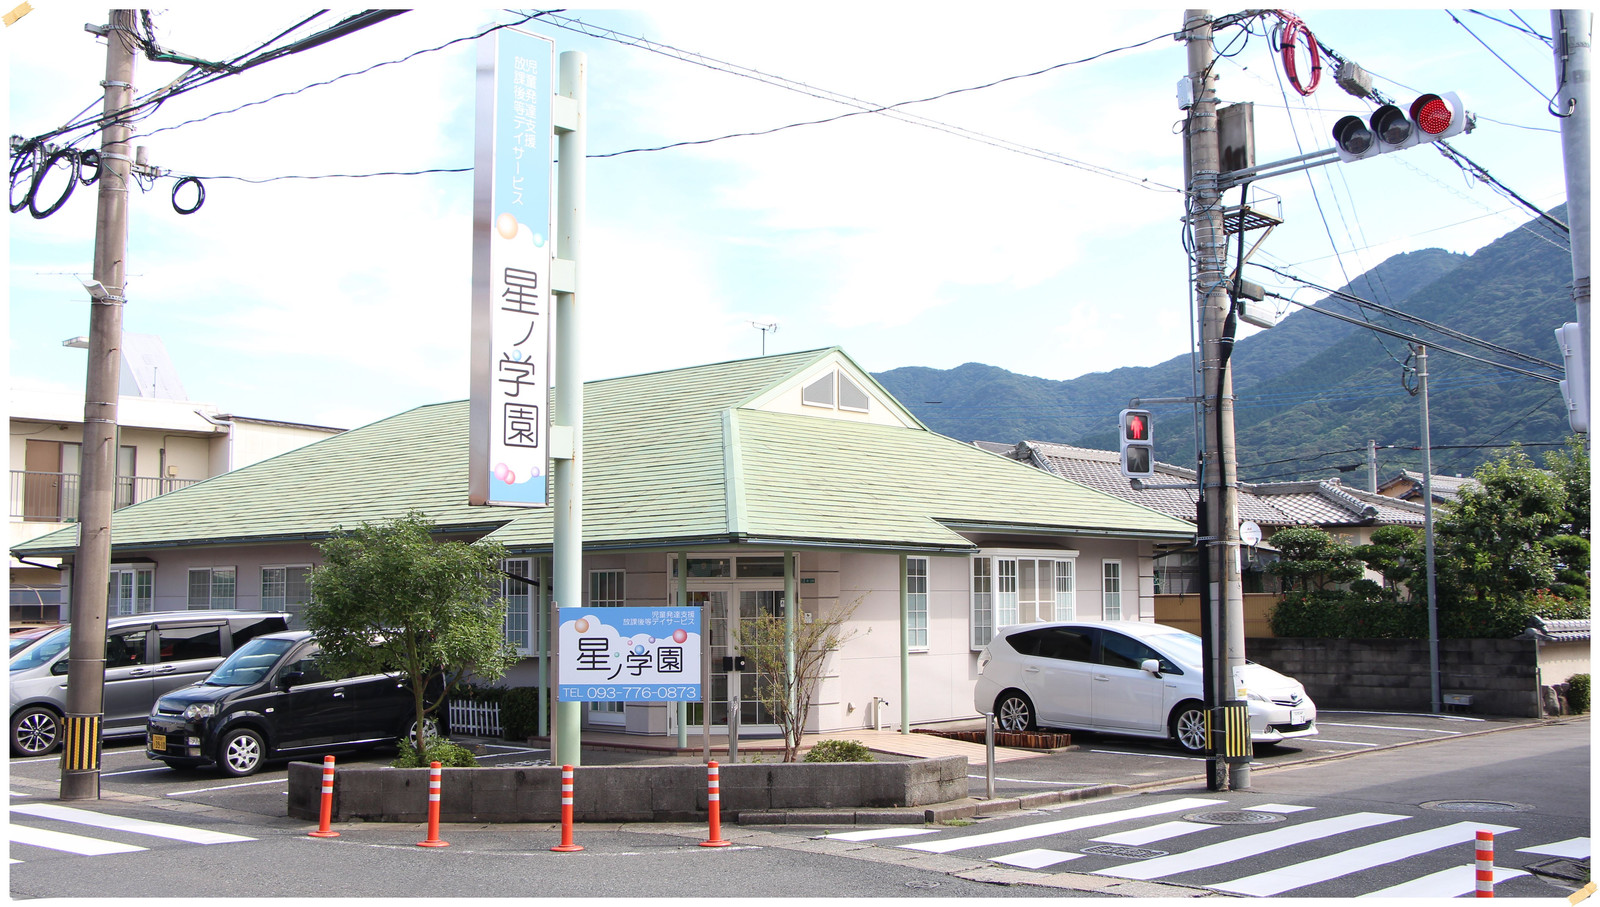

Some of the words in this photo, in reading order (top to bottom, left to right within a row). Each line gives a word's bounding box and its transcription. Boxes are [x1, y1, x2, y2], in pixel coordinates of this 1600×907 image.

[525, 60, 538, 149] 児童発達支援
[513, 56, 526, 206] 放課後等デイサービス
[498, 267, 540, 448] 星ノ学園
[622, 618, 695, 626] 放課後等デイサービス
[651, 610, 695, 619] 児童発達支援
[576, 637, 683, 680] 星ノ学園
[563, 688, 584, 698] TEL
[587, 687, 696, 699] 093-776-0873
